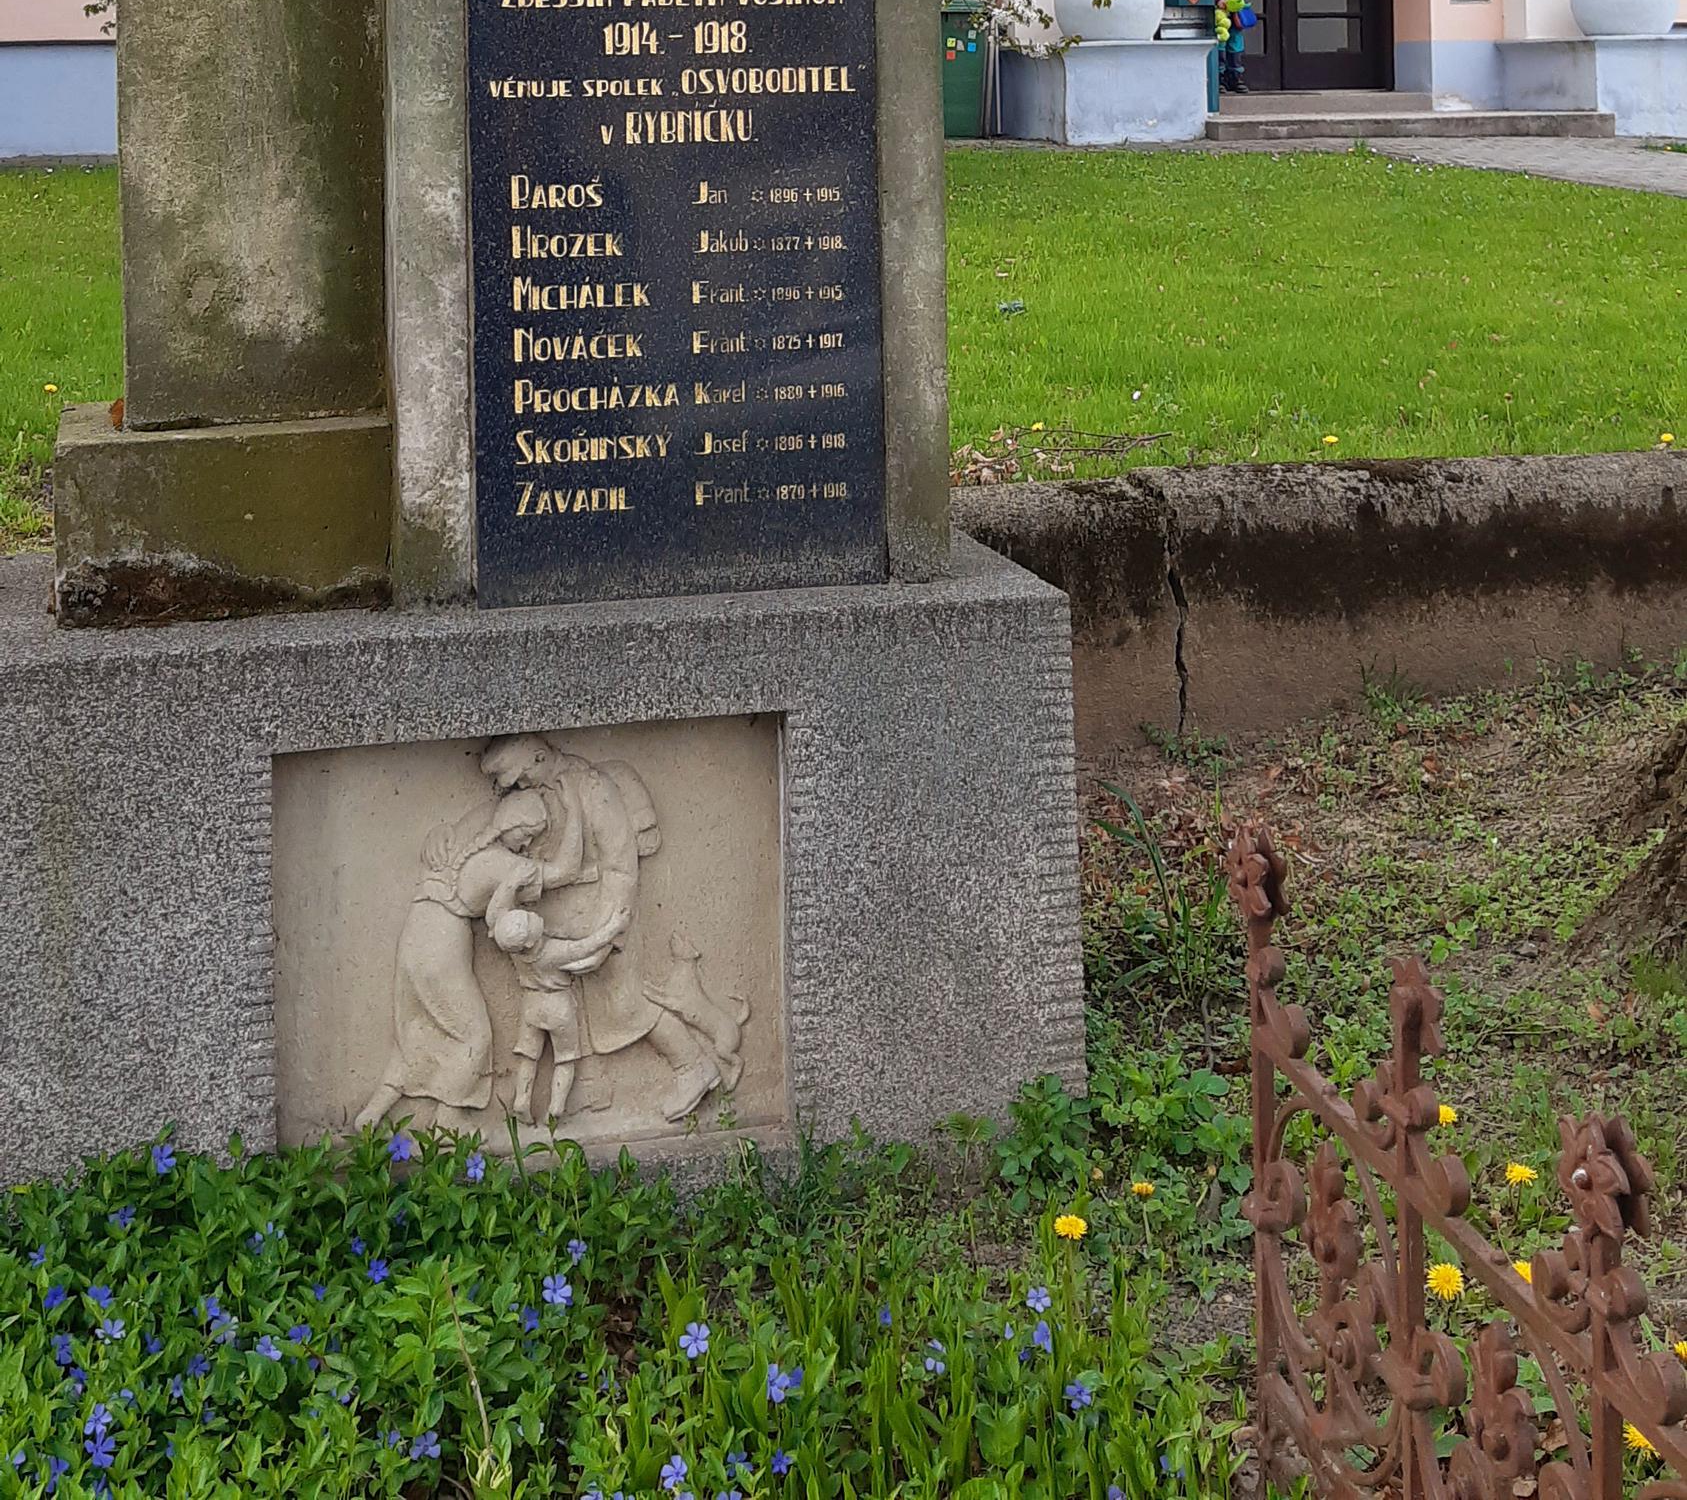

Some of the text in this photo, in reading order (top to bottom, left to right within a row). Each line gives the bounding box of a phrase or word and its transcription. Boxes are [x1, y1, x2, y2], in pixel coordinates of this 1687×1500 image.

[489, 76, 572, 98] VĚNUJE
[582, 78, 664, 98] SPOLEK
[692, 181, 728, 204] Jan
[769, 187, 799, 203] 1896
[694, 229, 749, 253] Jakub
[771, 236, 800, 251] 1877
[772, 334, 801, 350] 1875
[694, 379, 746, 405] Karel
[694, 429, 749, 455] Josef
[774, 434, 804, 451] 1896
